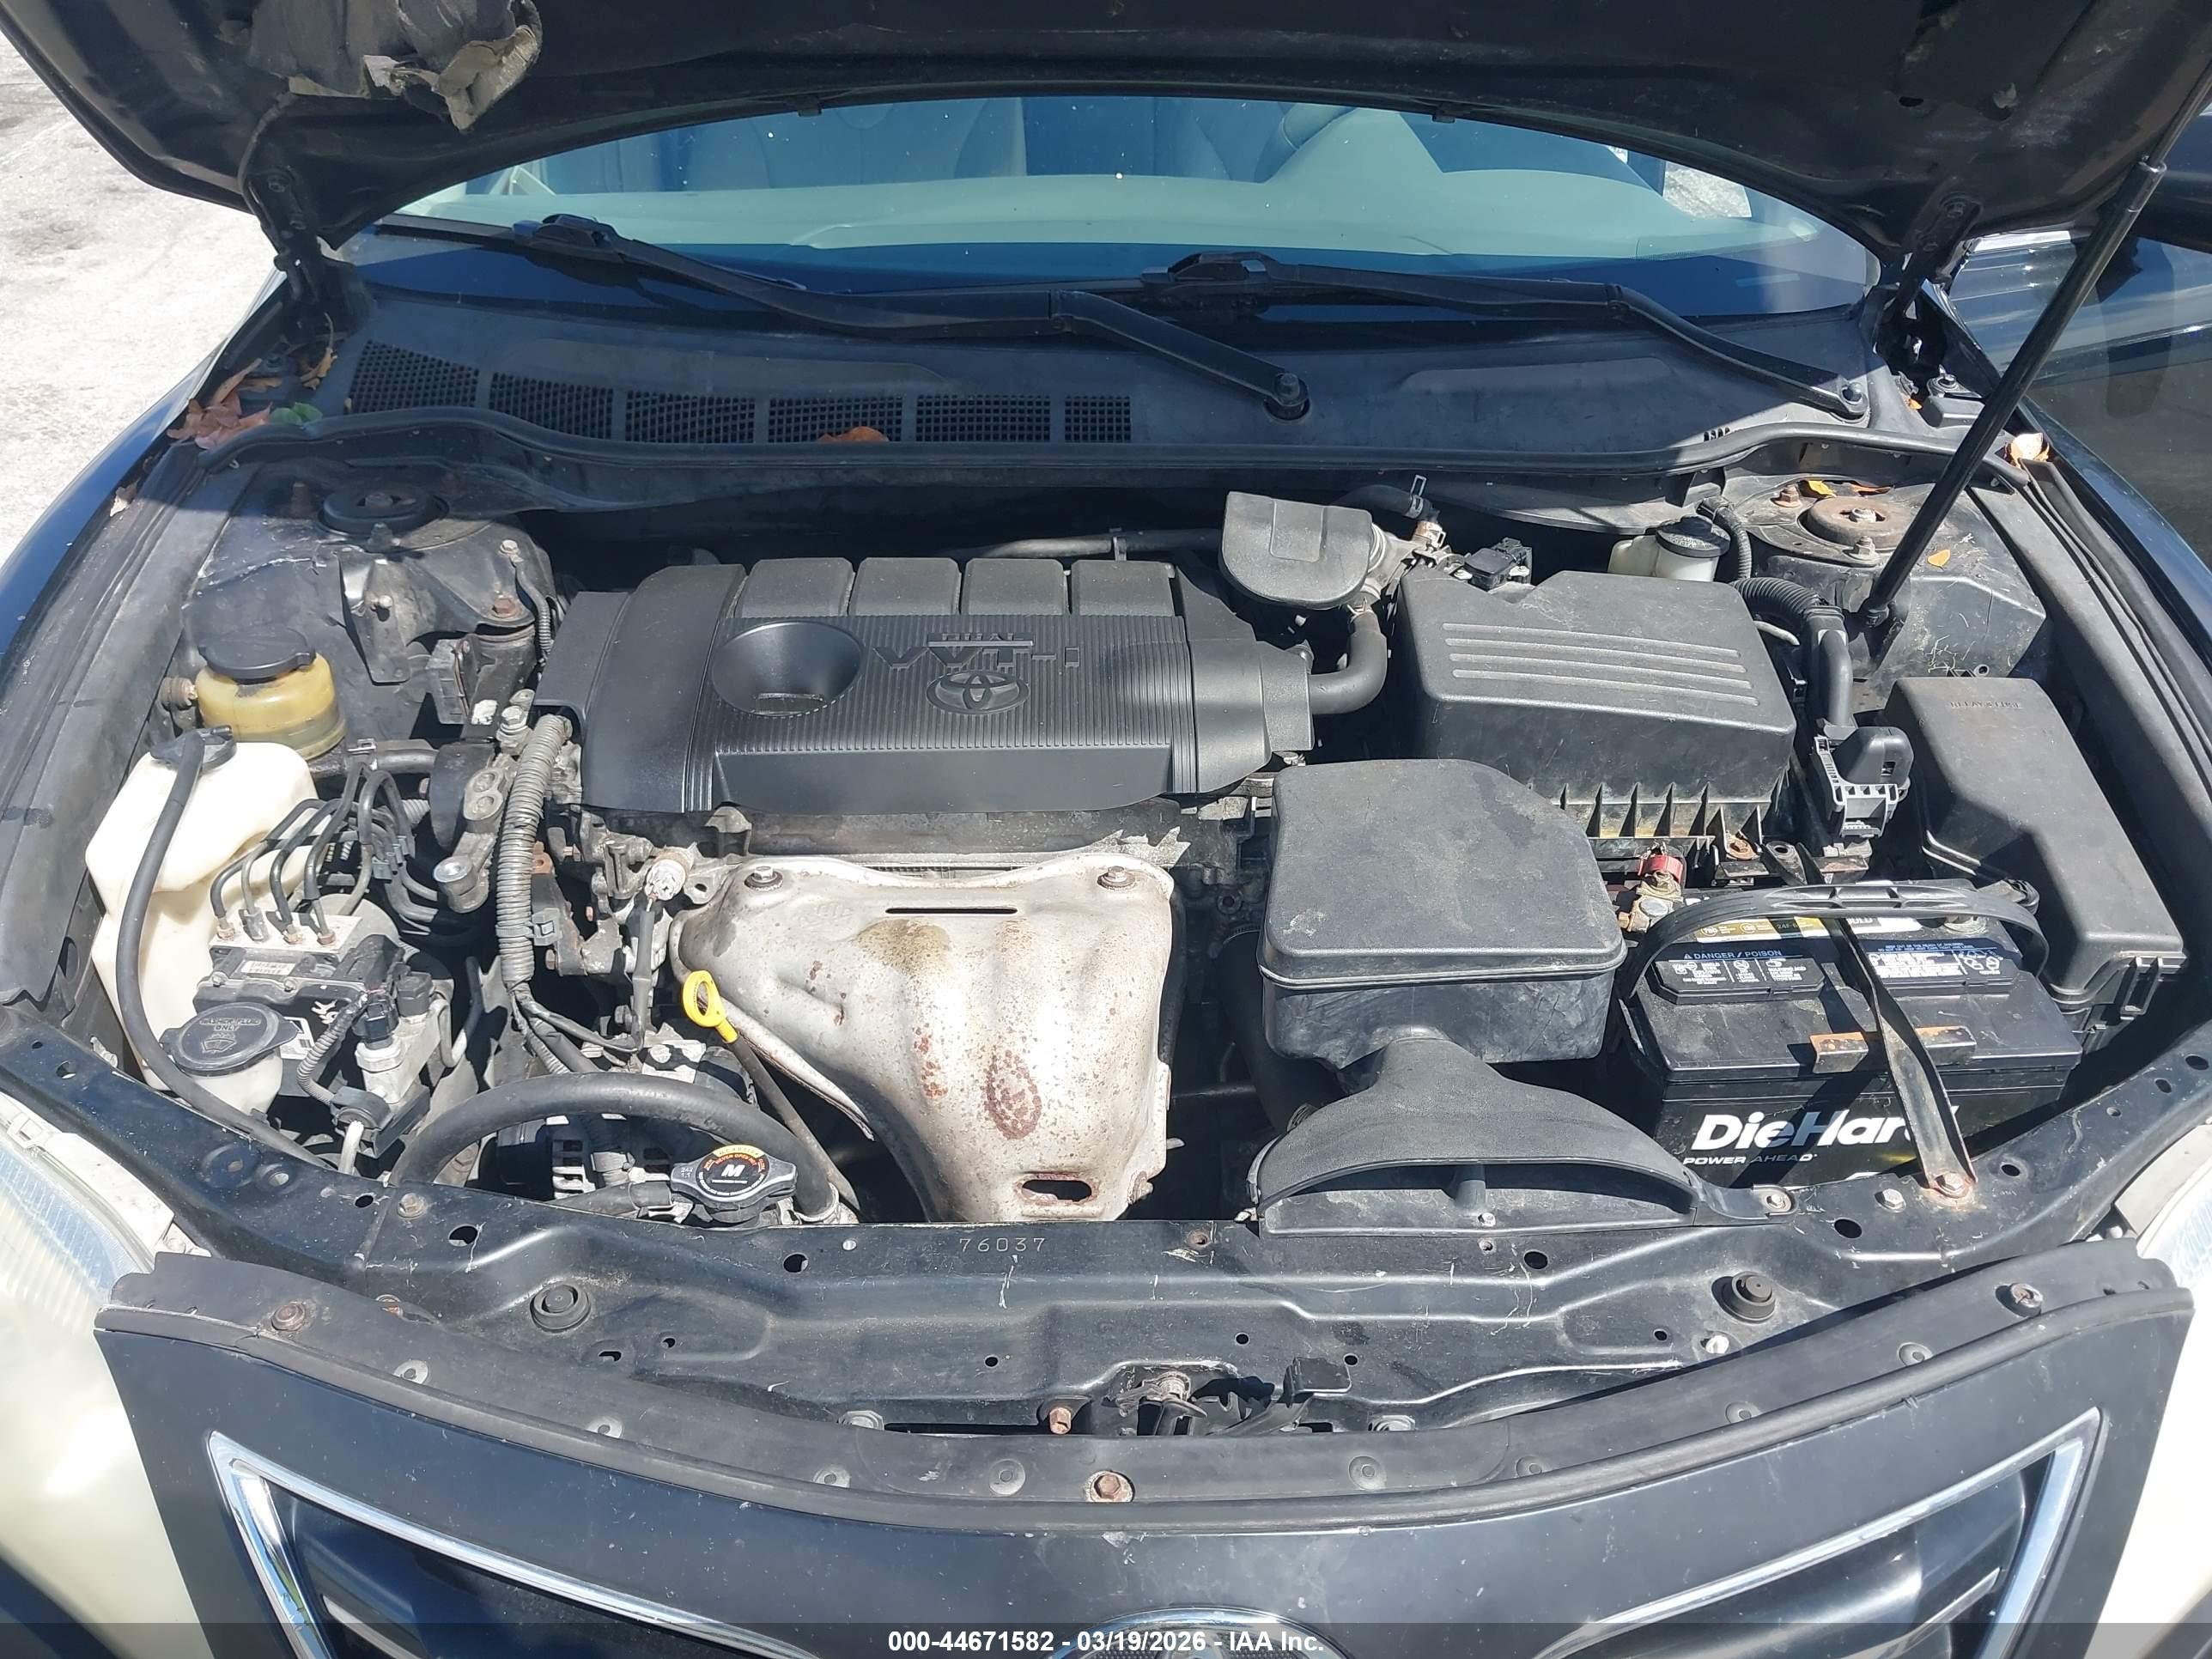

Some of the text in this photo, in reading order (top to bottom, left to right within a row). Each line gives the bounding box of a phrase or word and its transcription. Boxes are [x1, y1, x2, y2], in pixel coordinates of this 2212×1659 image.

[1744, 949, 1783, 958] POISON
[1690, 1105, 1960, 1150] DieHar
[1682, 1153, 1814, 1165] POWER AHEAD
[959, 1237, 1046, 1253] 76037
